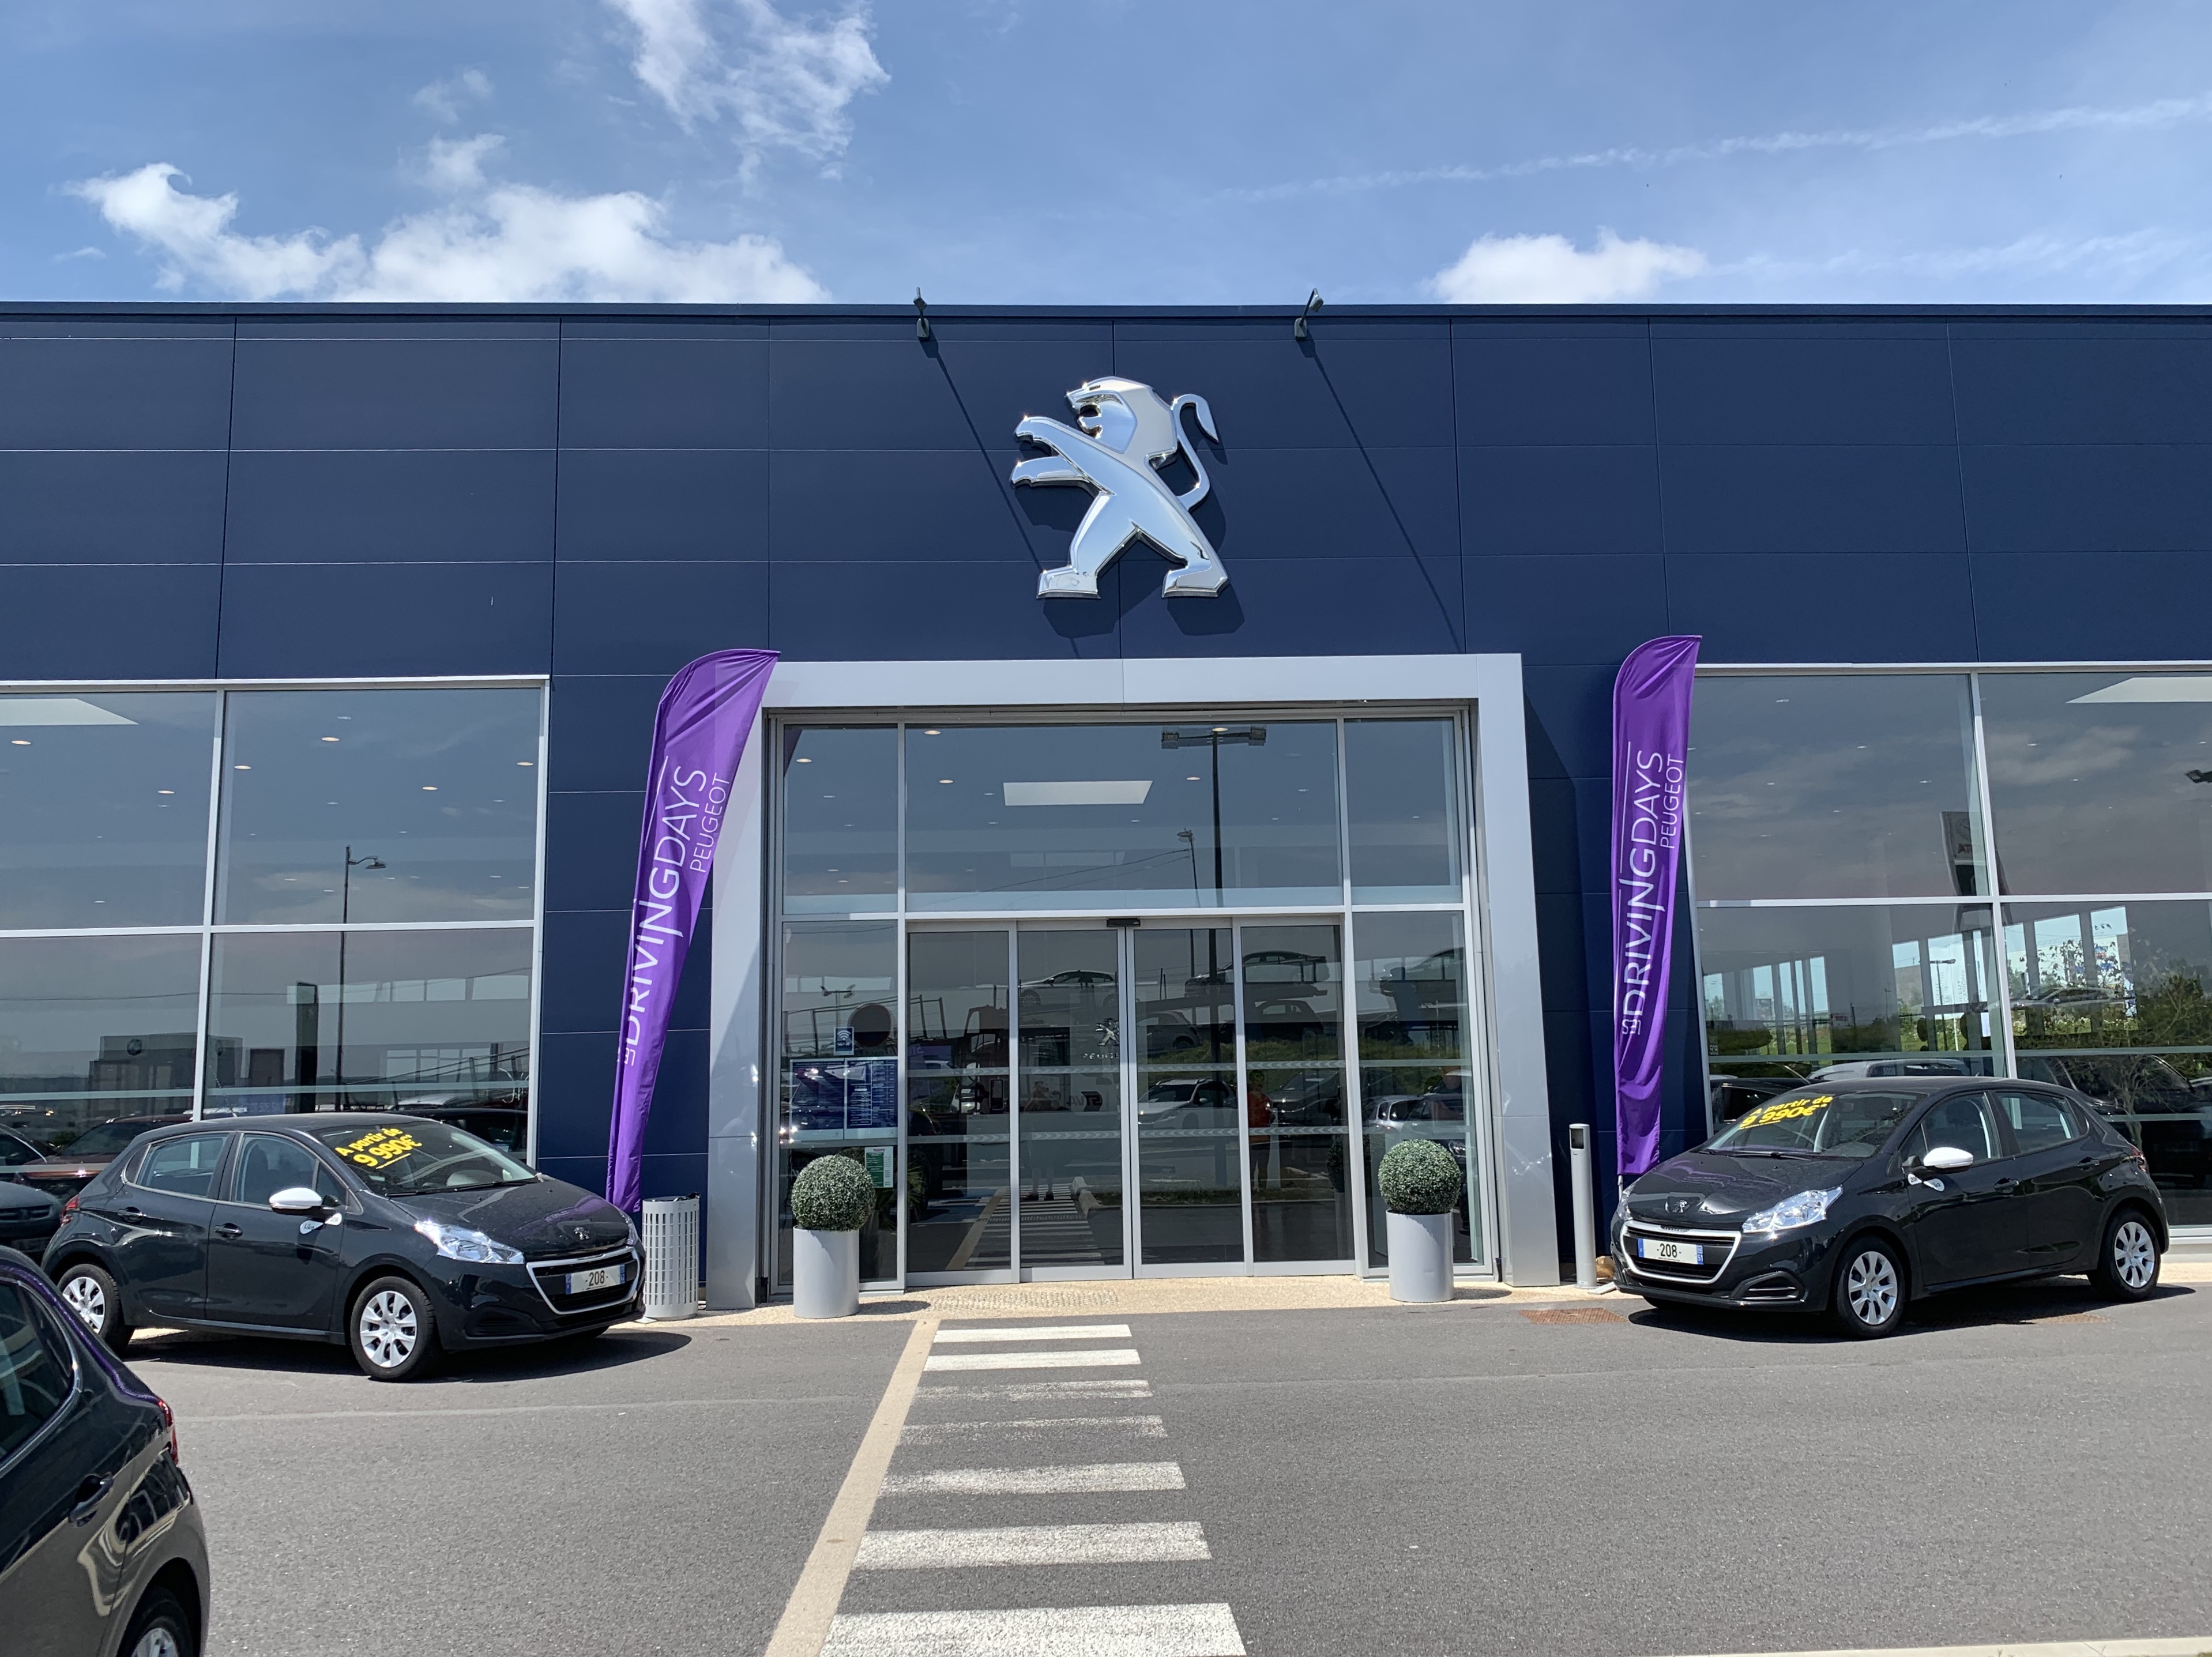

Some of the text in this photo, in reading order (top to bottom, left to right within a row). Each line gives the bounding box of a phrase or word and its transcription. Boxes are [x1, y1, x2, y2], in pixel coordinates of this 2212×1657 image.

[1660, 753, 1684, 849] PEUGEOT
[689, 772, 730, 873] PEUGEOT
[617, 1046, 636, 1067] LE
[1749, 1095, 1834, 1116] A partir de
[1739, 1115, 1758, 1128] 9
[334, 1128, 404, 1157] A partir de
[353, 1154, 378, 1168] 9
